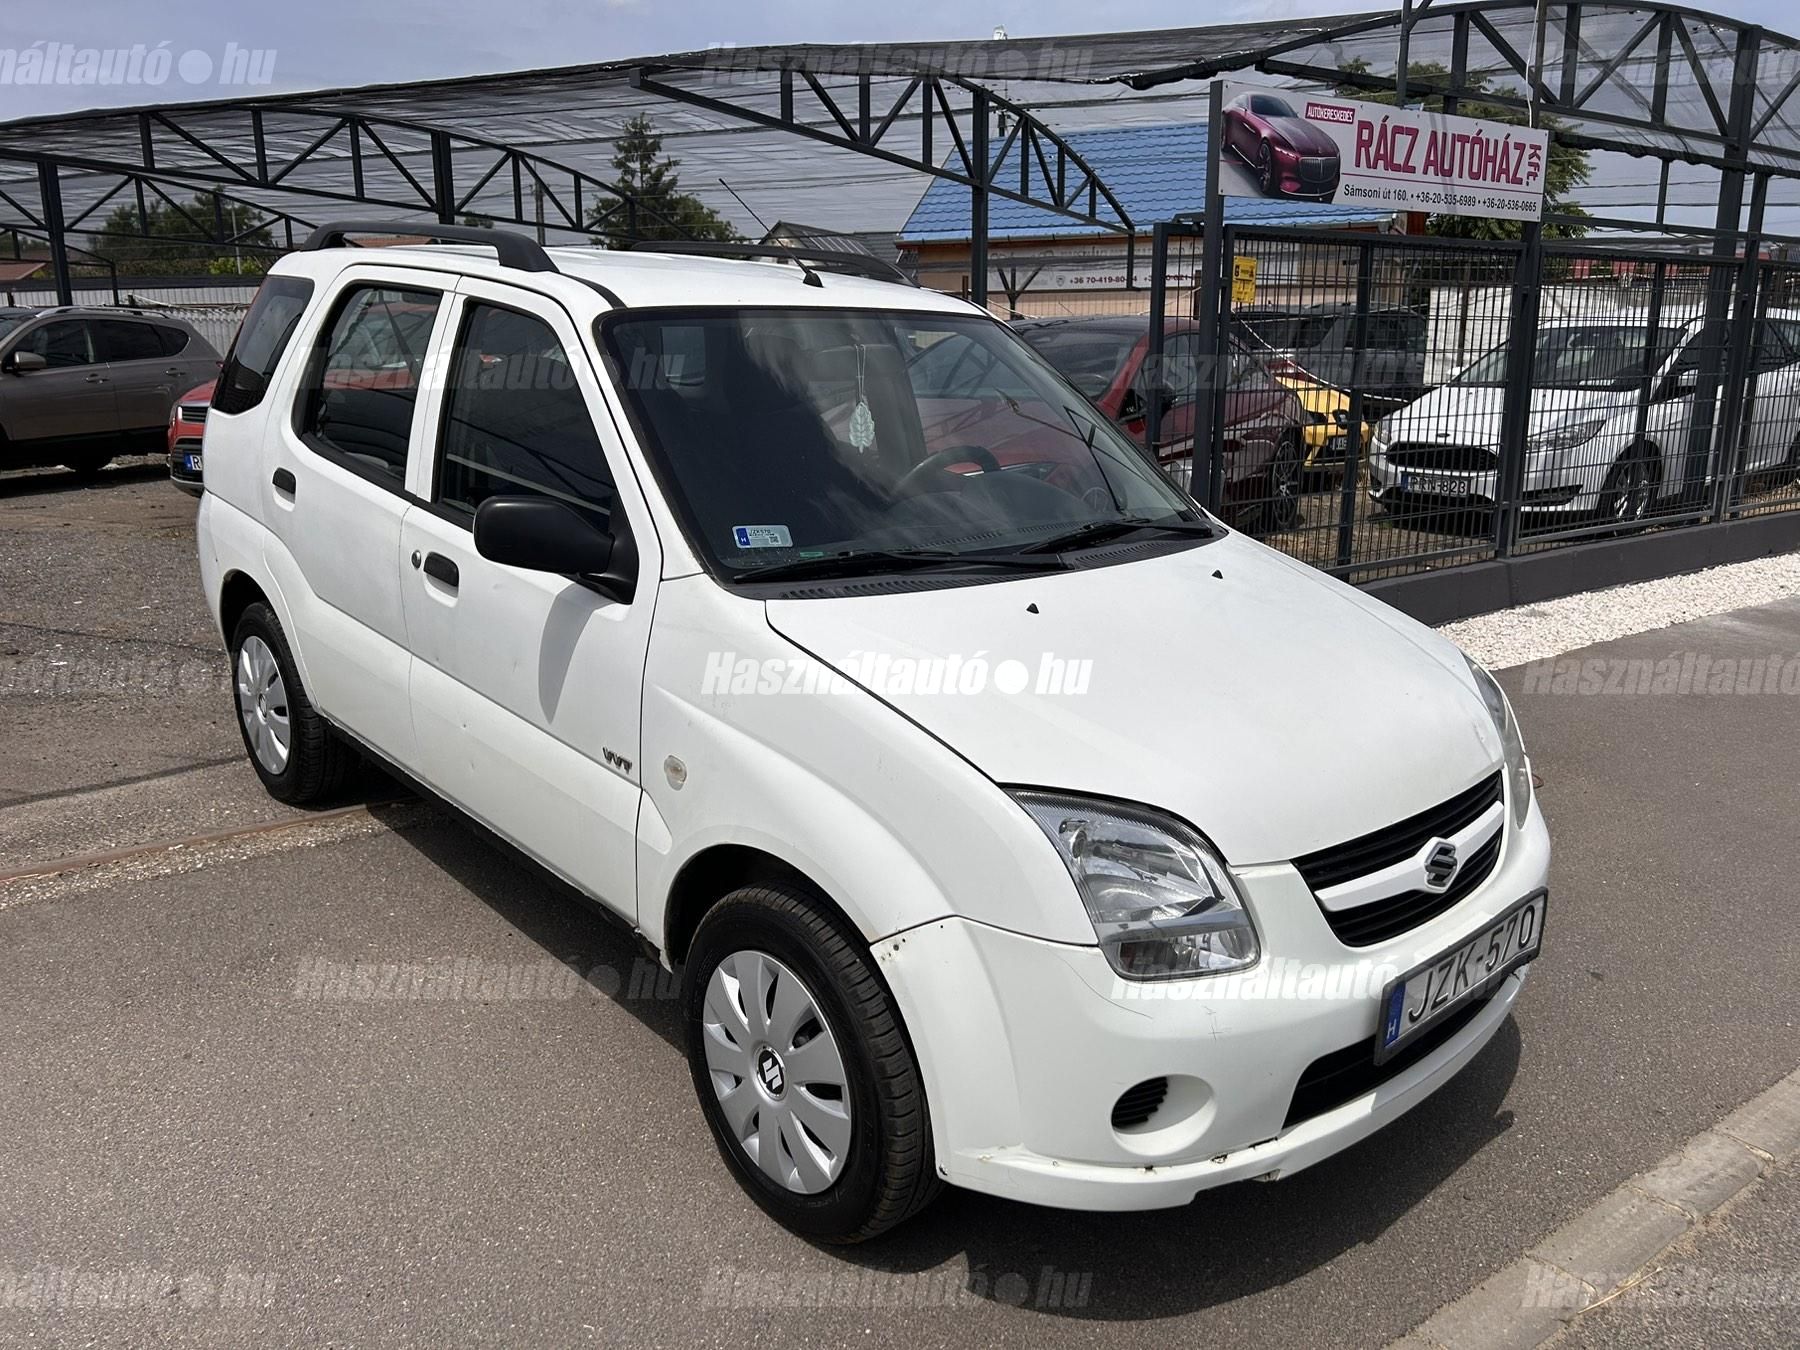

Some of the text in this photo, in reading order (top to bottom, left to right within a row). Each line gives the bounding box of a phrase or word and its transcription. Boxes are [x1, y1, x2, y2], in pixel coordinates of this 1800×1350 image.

[1354, 115, 1526, 185] RÁCZ AUTÓHÁZ
[1525, 143, 1542, 187] Kft.
[1343, 183, 1380, 199] Sámsoni
[1382, 187, 1391, 201] út
[1393, 188, 1409, 202] 160.
[1410, 476, 1467, 495] PRN-823
[1407, 903, 1536, 1024] JZK-570
[1386, 1018, 1397, 1040] H
